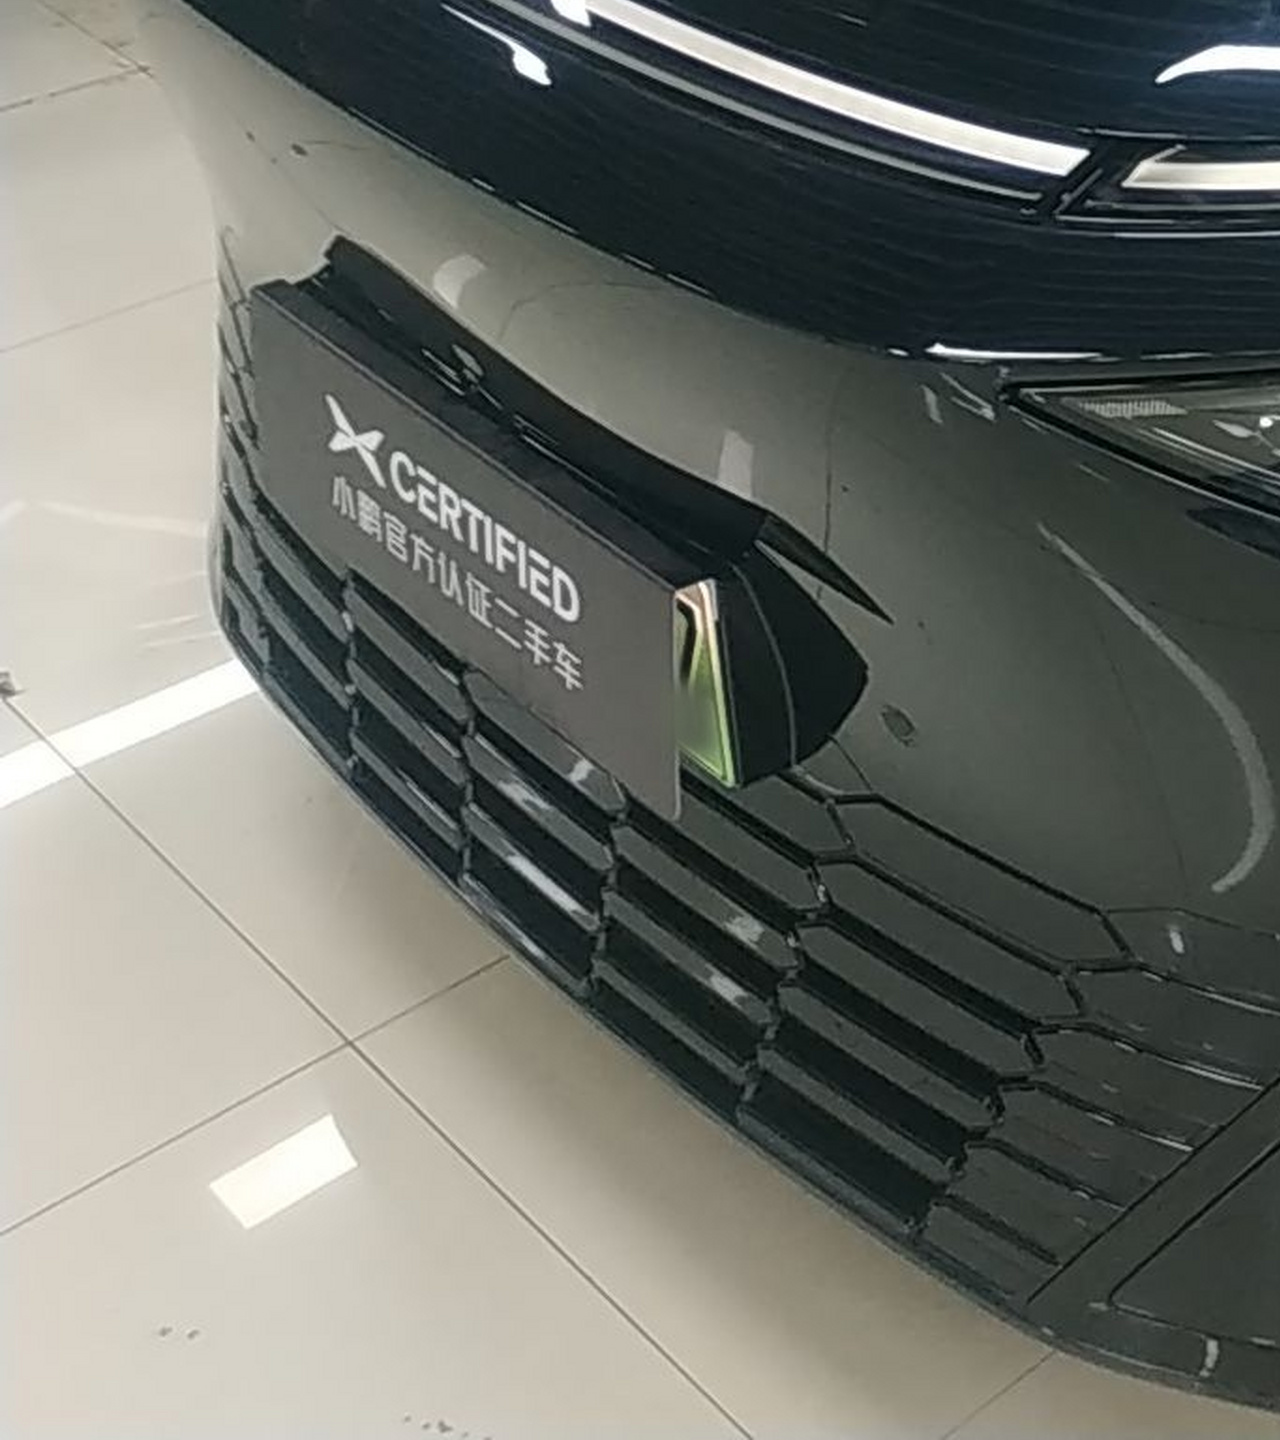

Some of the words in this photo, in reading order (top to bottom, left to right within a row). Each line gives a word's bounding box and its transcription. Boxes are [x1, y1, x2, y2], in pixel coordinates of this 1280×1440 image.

[331, 476, 584, 690] 小鹏官方认证二手车
[389, 450, 581, 622] CERTIFIED
